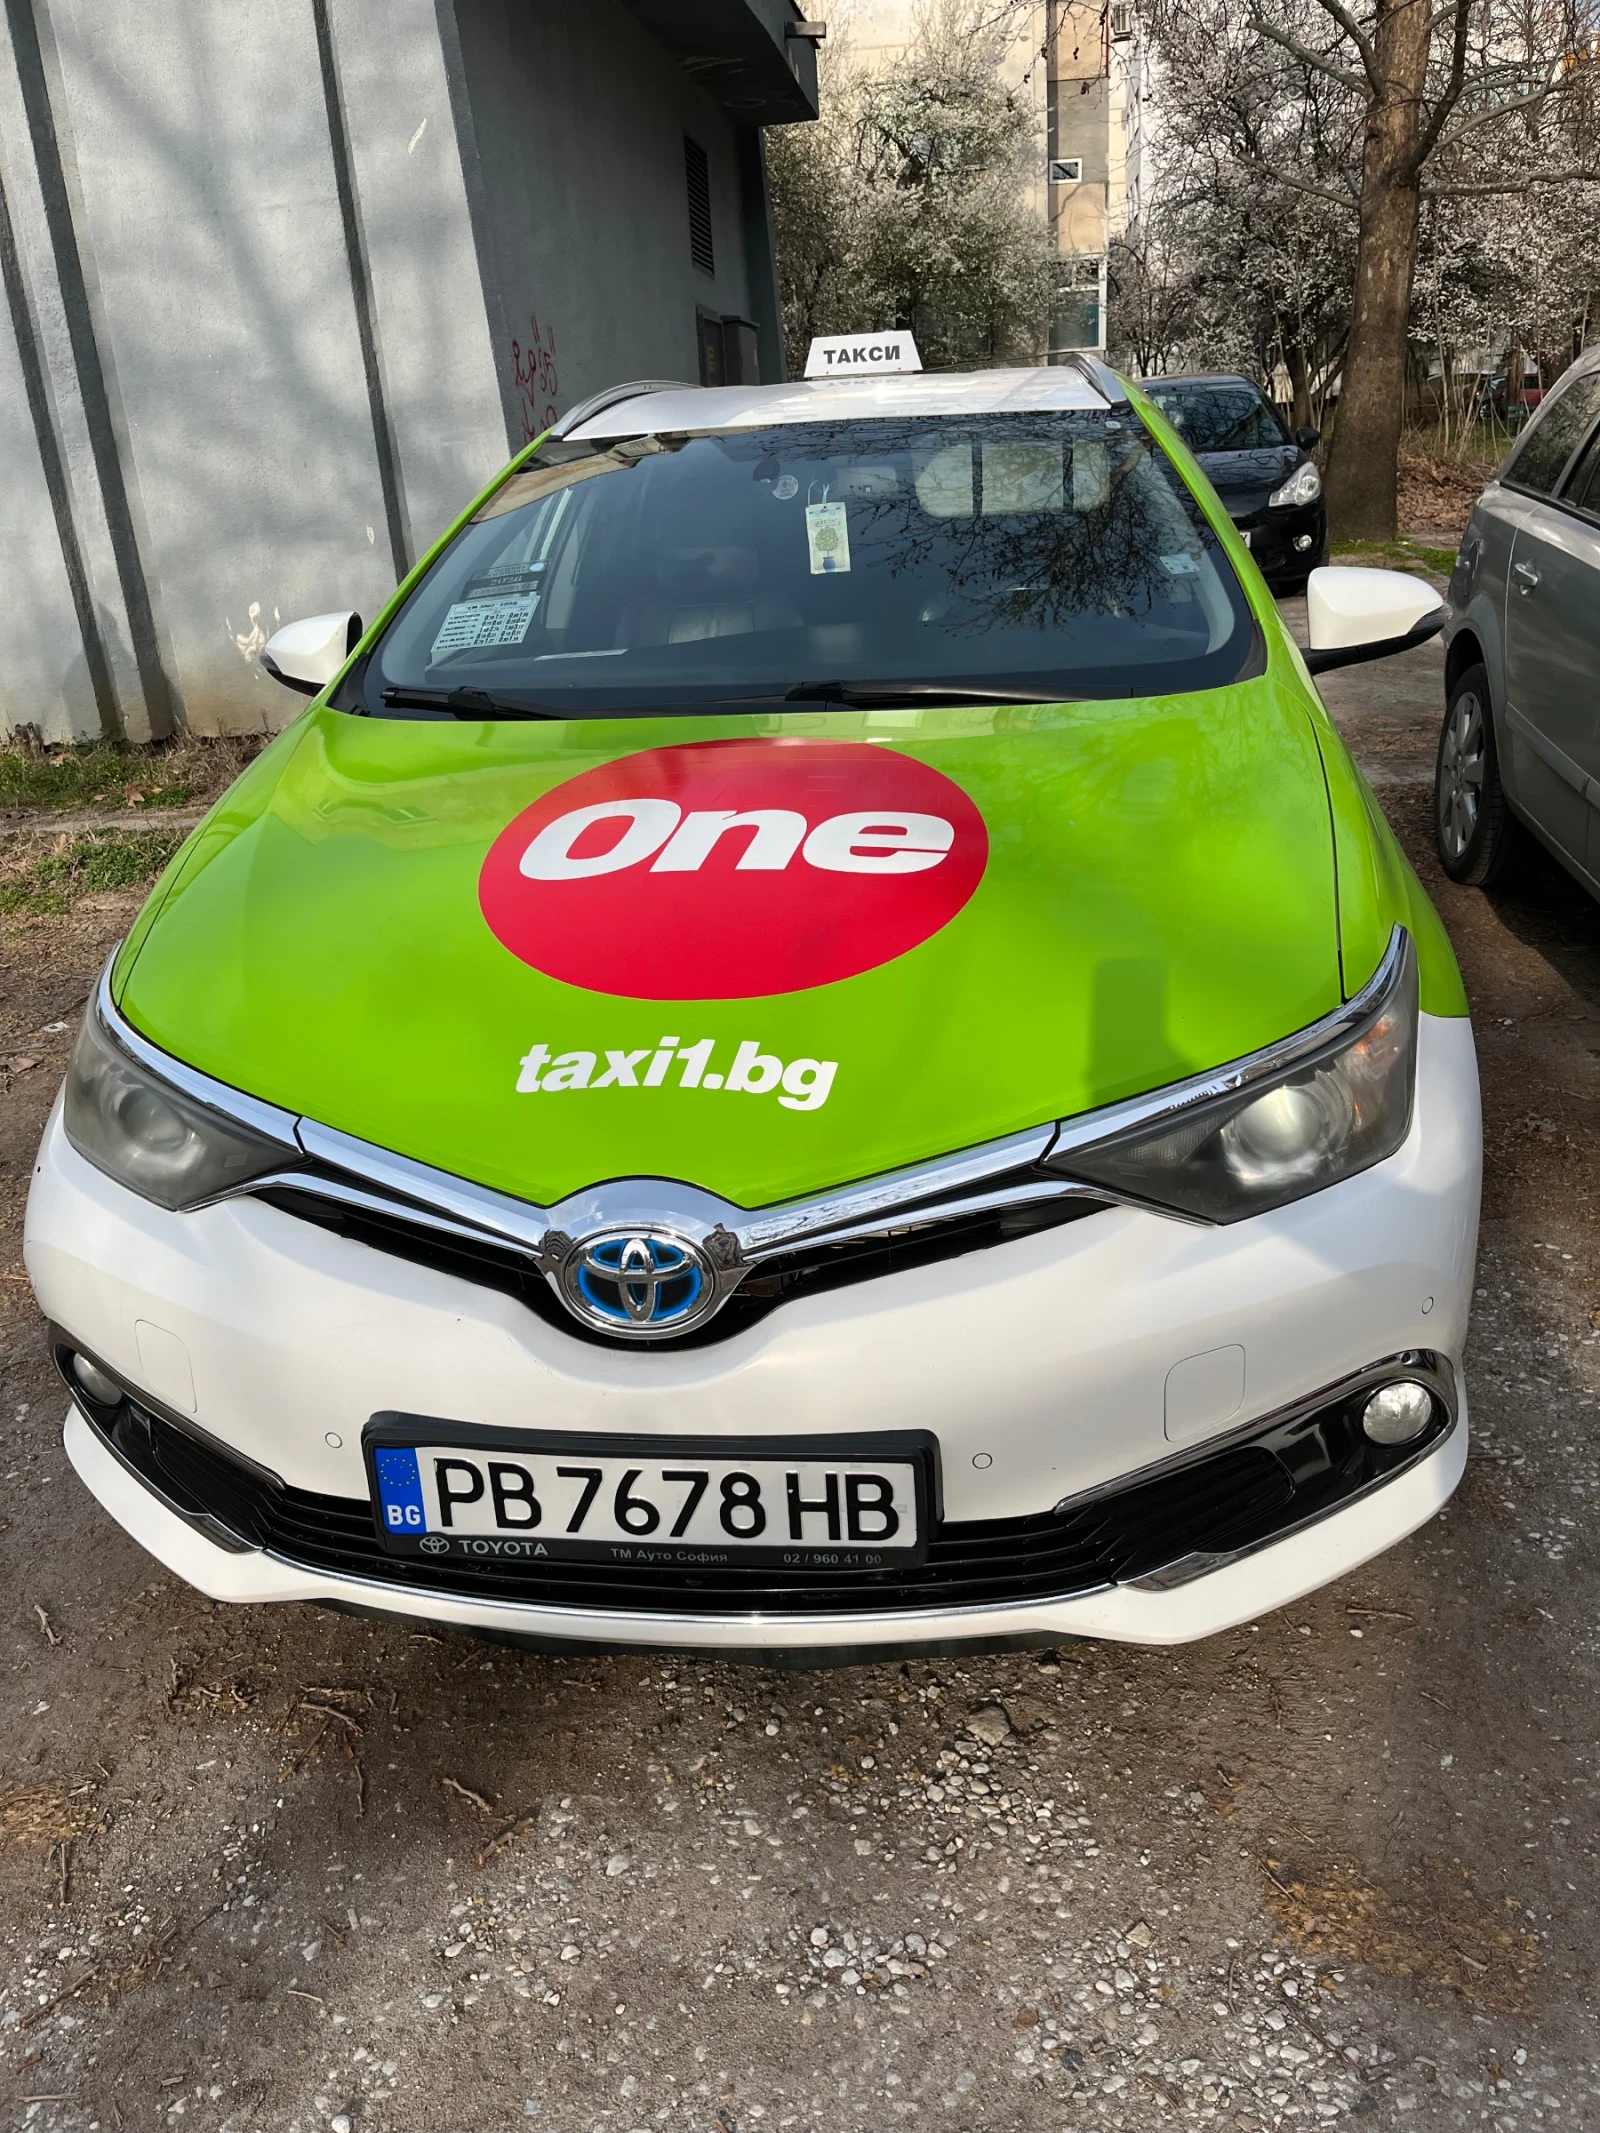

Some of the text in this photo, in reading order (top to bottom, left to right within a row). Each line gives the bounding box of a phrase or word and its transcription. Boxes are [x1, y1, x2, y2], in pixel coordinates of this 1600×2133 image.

[823, 345, 900, 365] ТАКСИ
[515, 1036, 839, 1111] taxi1.bg
[433, 1457, 899, 1541] PB 7678 HB
[387, 1505, 421, 1525] BG
[458, 1540, 549, 1556] TOYOTA
[676, 1551, 728, 1563] София
[783, 1553, 800, 1563] 02
[813, 1554, 839, 1564] 960
[843, 1554, 860, 1564] 41
[865, 1555, 882, 1564] 00
